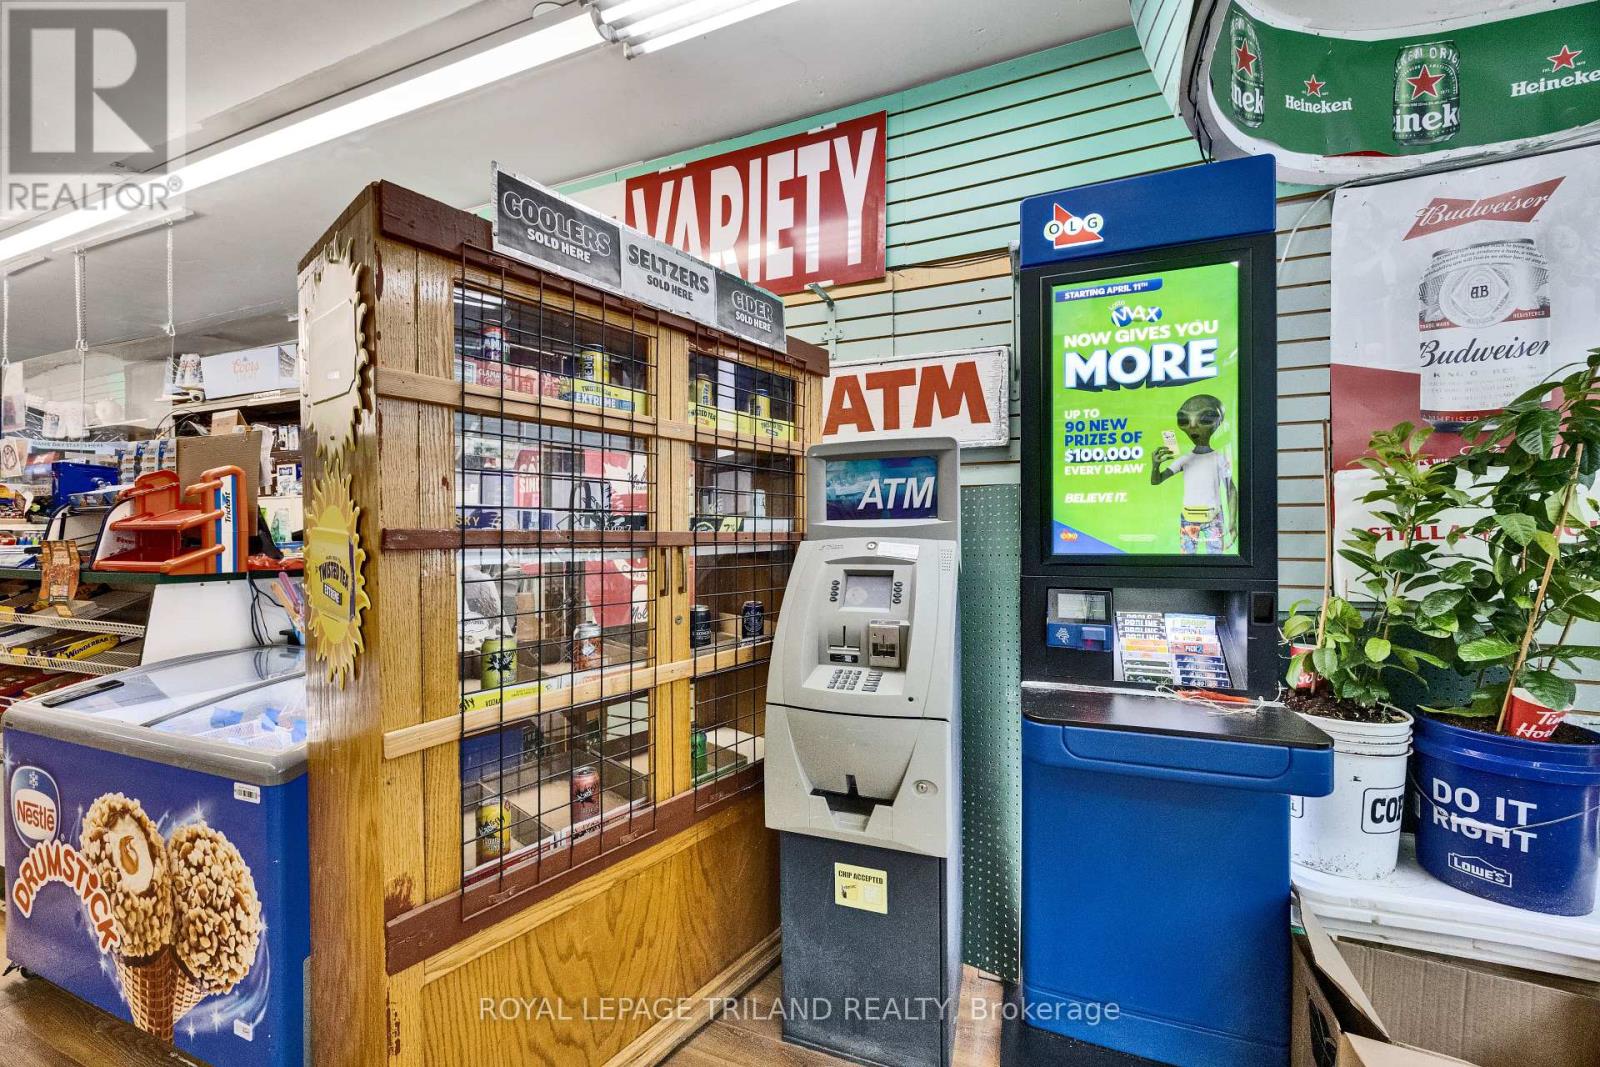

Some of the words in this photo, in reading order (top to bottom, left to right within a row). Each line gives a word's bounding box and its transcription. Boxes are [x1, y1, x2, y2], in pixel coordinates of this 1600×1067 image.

[1285, 94, 1353, 114] Heineken
[631, 127, 878, 283] VARIETY
[1416, 194, 1549, 227] Budweiser
[503, 191, 611, 257] COOLERS
[1048, 216, 1098, 235] OLG
[527, 228, 560, 250] SOLD
[561, 241, 591, 264] HERE
[628, 243, 710, 295] SELTZERS
[646, 275, 671, 292] SOLD
[671, 284, 694, 302] HERE
[1064, 287, 1106, 300] STARTING
[1106, 284, 1132, 295] APRIL
[1132, 282, 1149, 291] 11TH
[1470, 285, 1489, 299] AB
[731, 290, 774, 323] CIDER
[1111, 304, 1161, 328] MAX
[735, 311, 753, 327] SOLD
[753, 319, 772, 333] HERE
[1063, 330, 1112, 348] NOW
[1115, 324, 1171, 343] GIVES
[1174, 319, 1219, 337] YOU
[1064, 338, 1219, 390] MORE
[1419, 337, 1551, 368] Budweiser
[478, 368, 507, 383] CLAMAO
[822, 361, 991, 436] ATM
[1064, 410, 1081, 419] UP
[1083, 408, 1100, 418] TO
[1065, 420, 1086, 433] 90
[1089, 418, 1128, 431] NEW
[1064, 433, 1117, 447] PRIZES
[1120, 431, 1143, 444] OF
[1064, 464, 1102, 476] EVERY
[1104, 463, 1145, 475] DRAW
[224, 491, 233, 524] Trident
[857, 476, 936, 510] ATM
[1064, 492, 1112, 504] BELIEVE
[1115, 492, 1128, 503] IT.
[65, 635, 110, 659] WONDERBAR
[1432, 777, 1480, 812] DO
[1496, 796, 1538, 826] IT
[1432, 805, 1538, 853] RIGHT
[838, 869, 852, 879] CHIP
[853, 872, 884, 885] ACCEPTED
[1453, 854, 1506, 884] LOWE'S
[14, 842, 119, 951] DRUMSTICK
